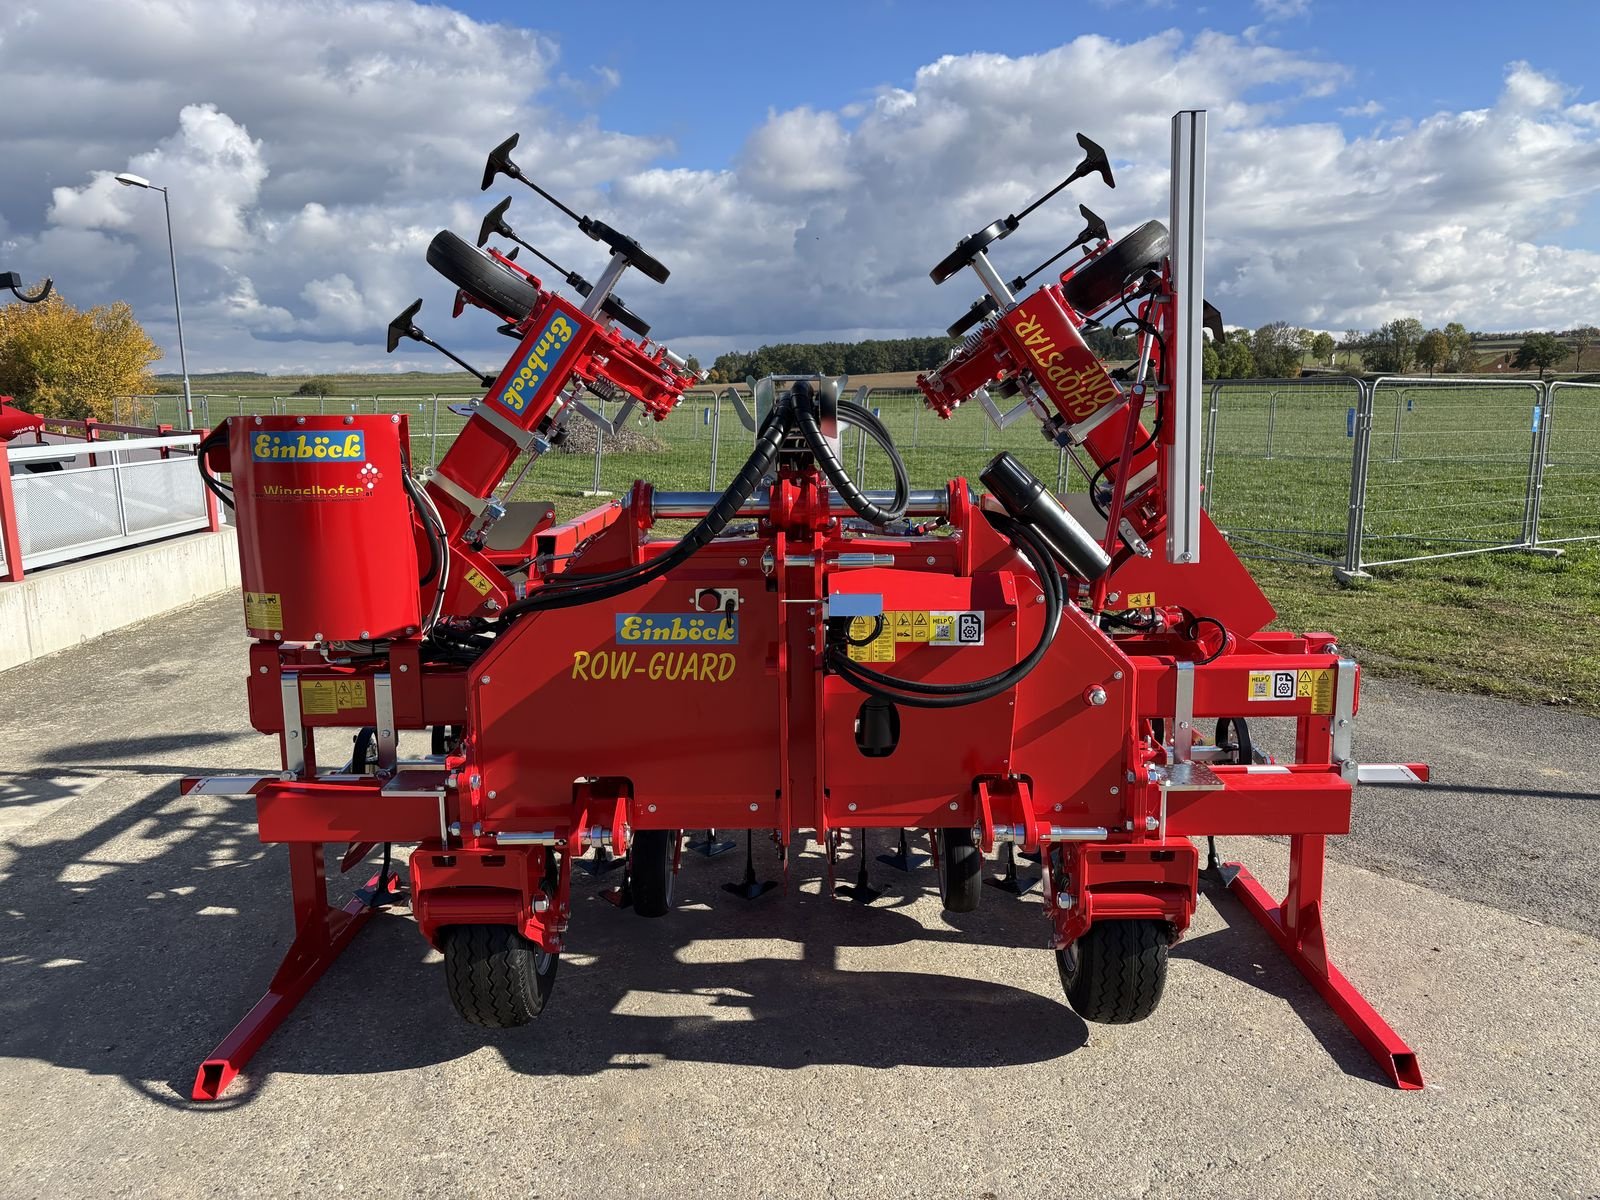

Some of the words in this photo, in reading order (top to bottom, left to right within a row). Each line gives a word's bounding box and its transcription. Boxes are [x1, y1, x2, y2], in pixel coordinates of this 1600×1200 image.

[504, 317, 572, 409] Einböck
[1015, 309, 1098, 416] CHOPSTAR-
[1075, 362, 1117, 403] ONE
[254, 434, 361, 458] Einböck
[621, 616, 735, 640] Einböck
[572, 651, 736, 682] ROW-GUARD
